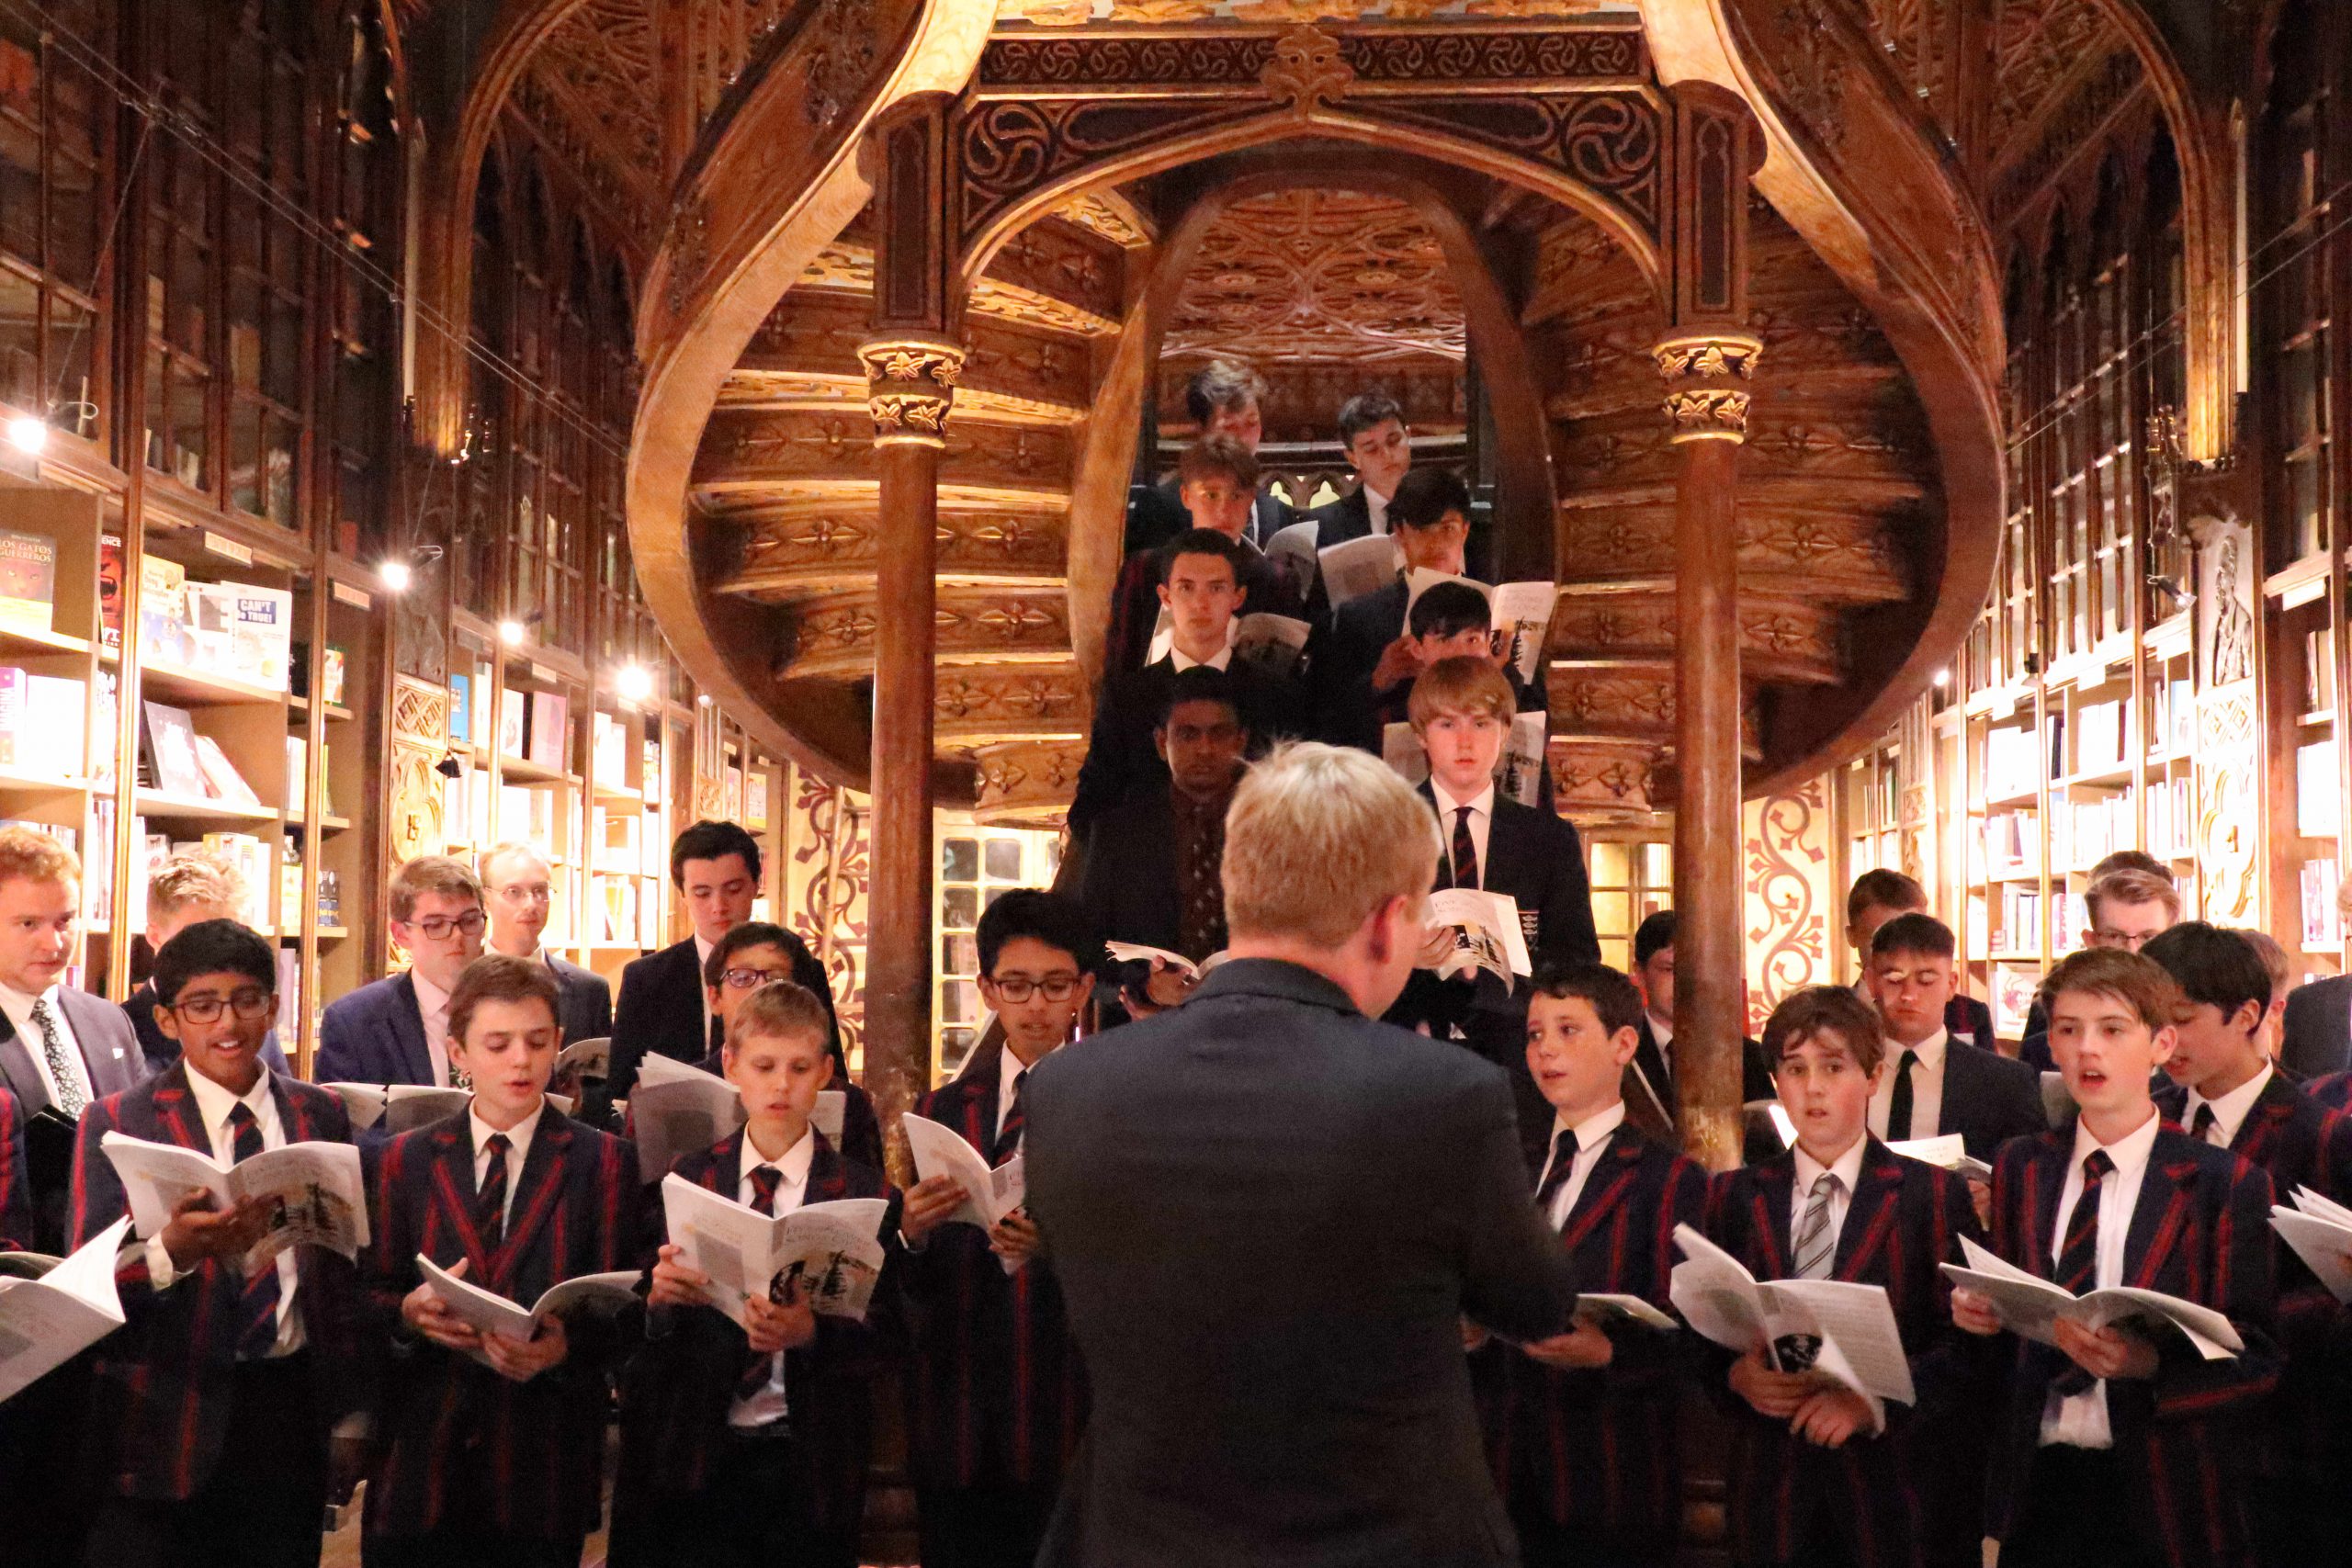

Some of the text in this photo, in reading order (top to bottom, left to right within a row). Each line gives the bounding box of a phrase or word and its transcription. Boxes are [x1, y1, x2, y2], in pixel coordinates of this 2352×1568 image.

[18, 542, 52, 555] GATOS
[240, 600, 272, 613] CAN'T
[247, 611, 273, 624] TRUE!
